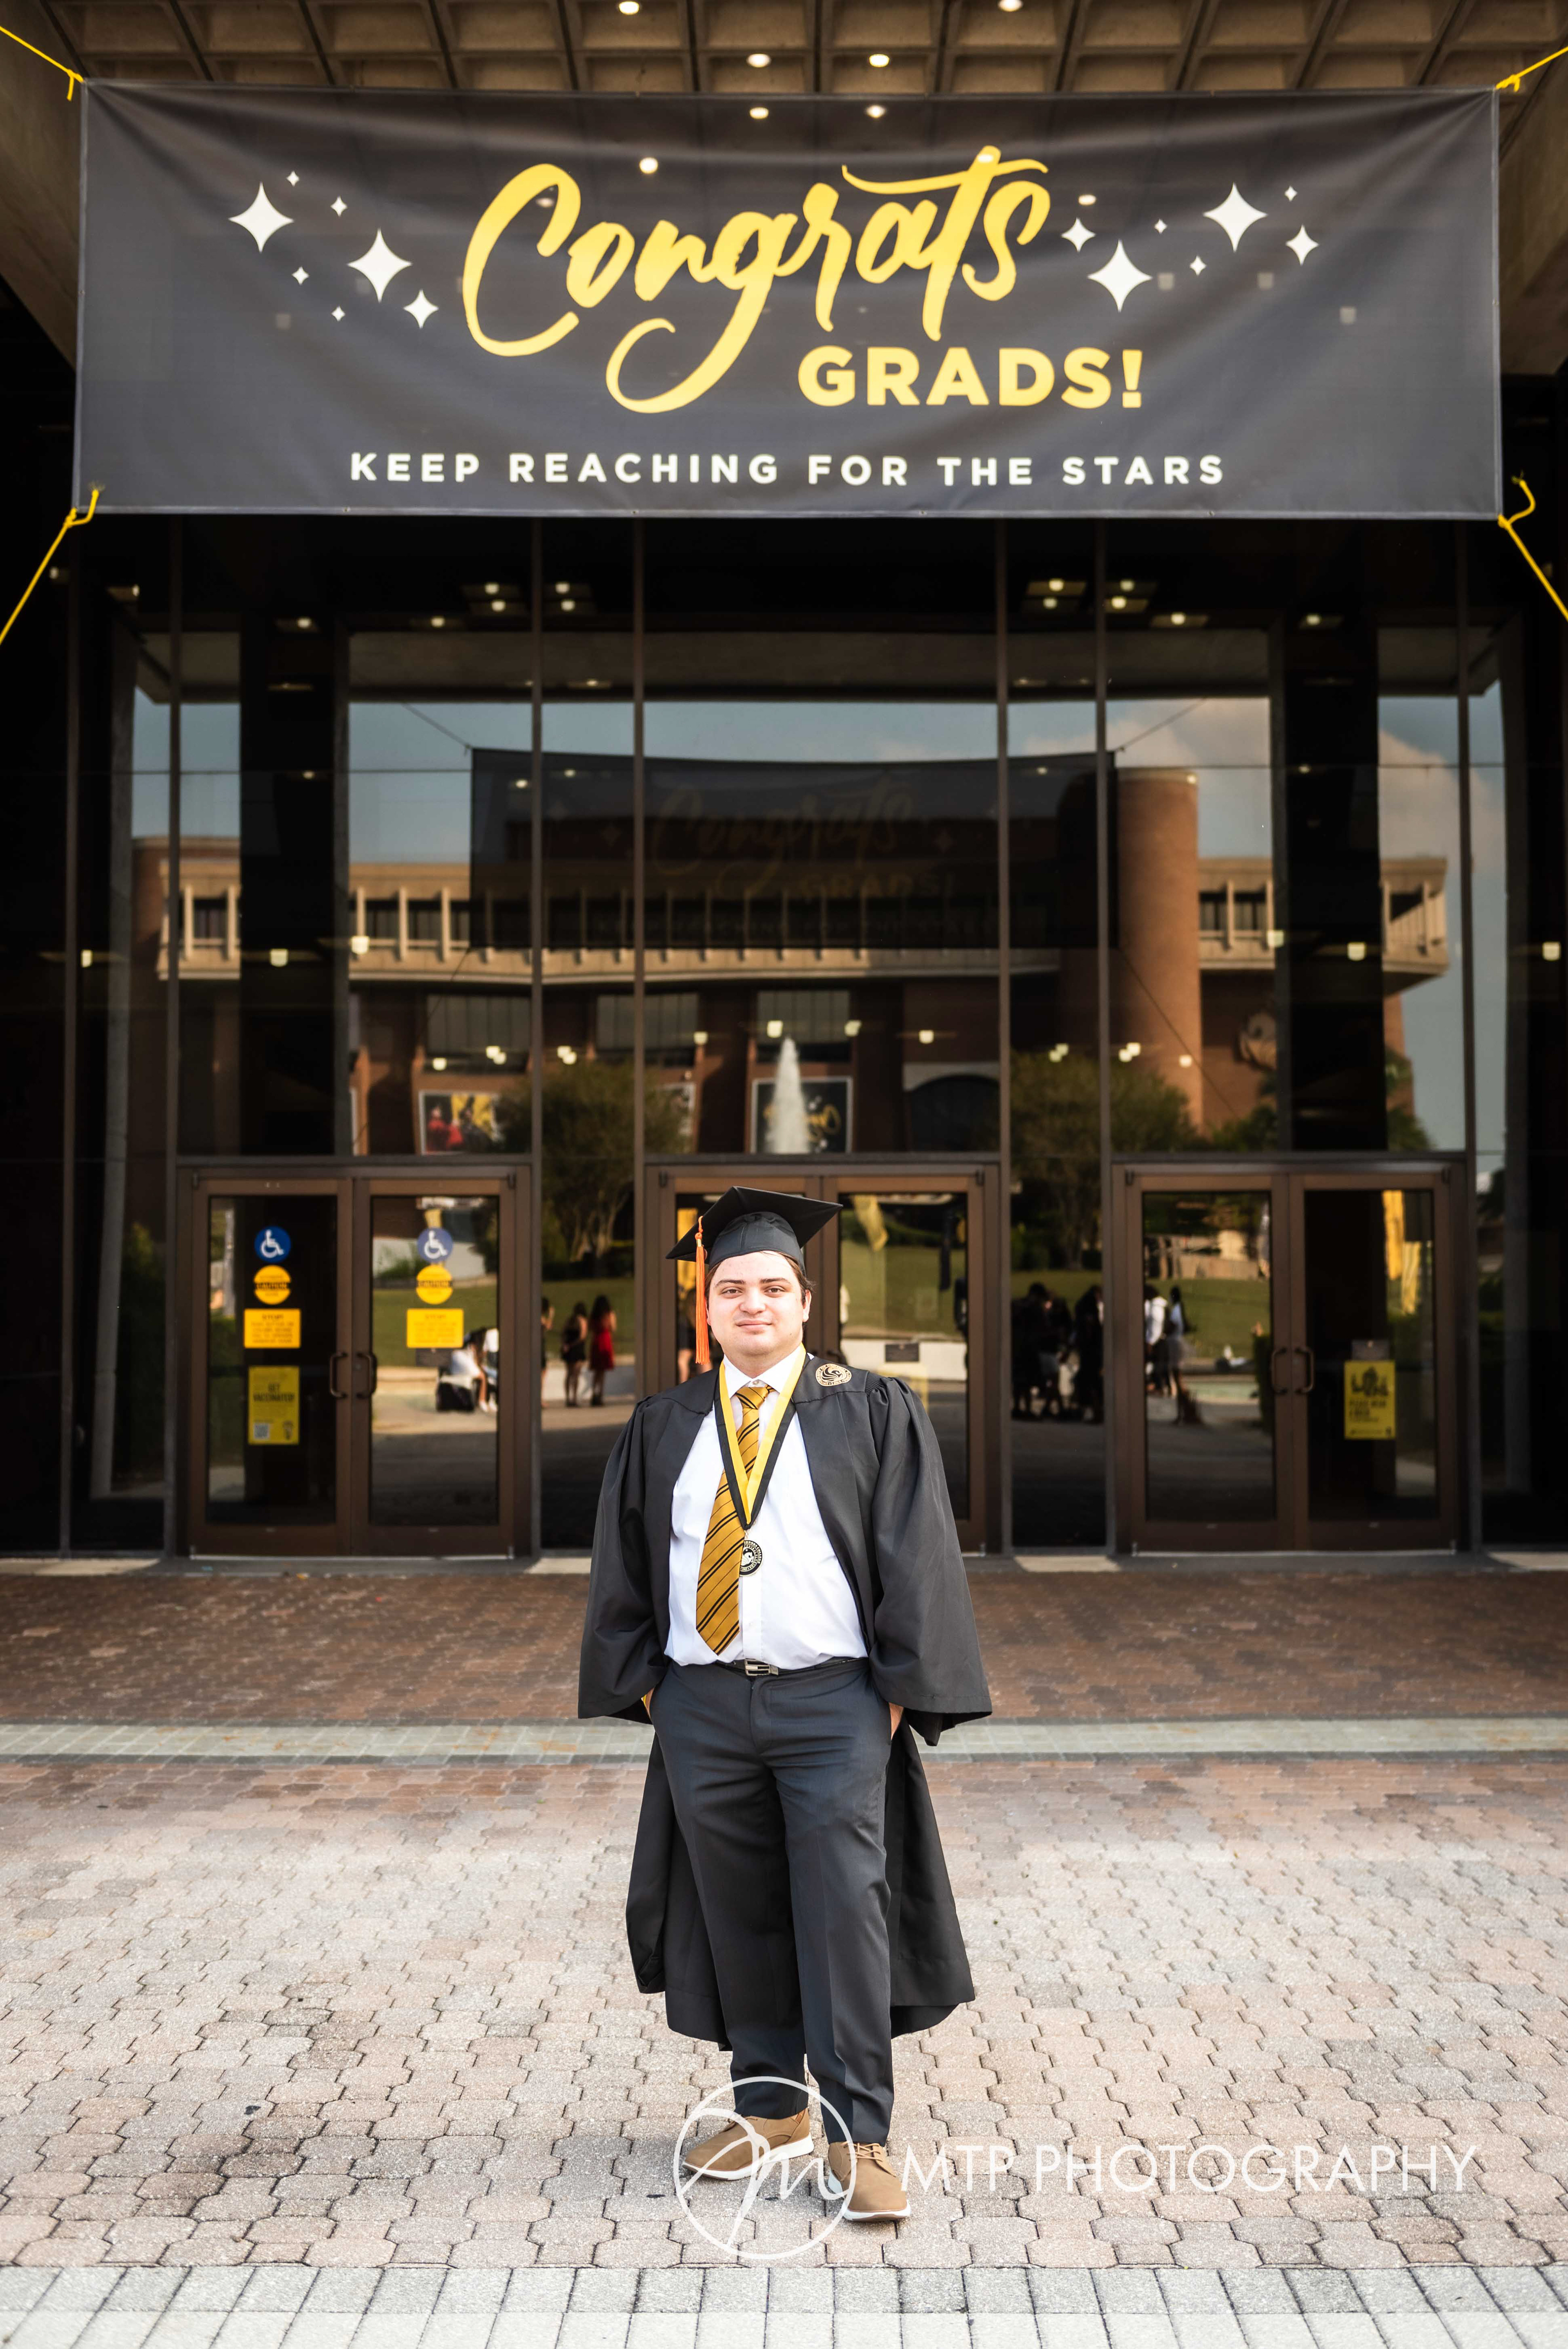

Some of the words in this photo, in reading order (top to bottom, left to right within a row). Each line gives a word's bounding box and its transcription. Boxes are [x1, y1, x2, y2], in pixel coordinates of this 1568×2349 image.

[461, 145, 1051, 414] Congrats
[797, 345, 1143, 409] GRADS!
[351, 452, 479, 482] KEEP
[510, 453, 777, 484] REACHING
[808, 455, 907, 486] FOR
[937, 457, 1032, 486] THE
[1062, 455, 1223, 485] STARS
